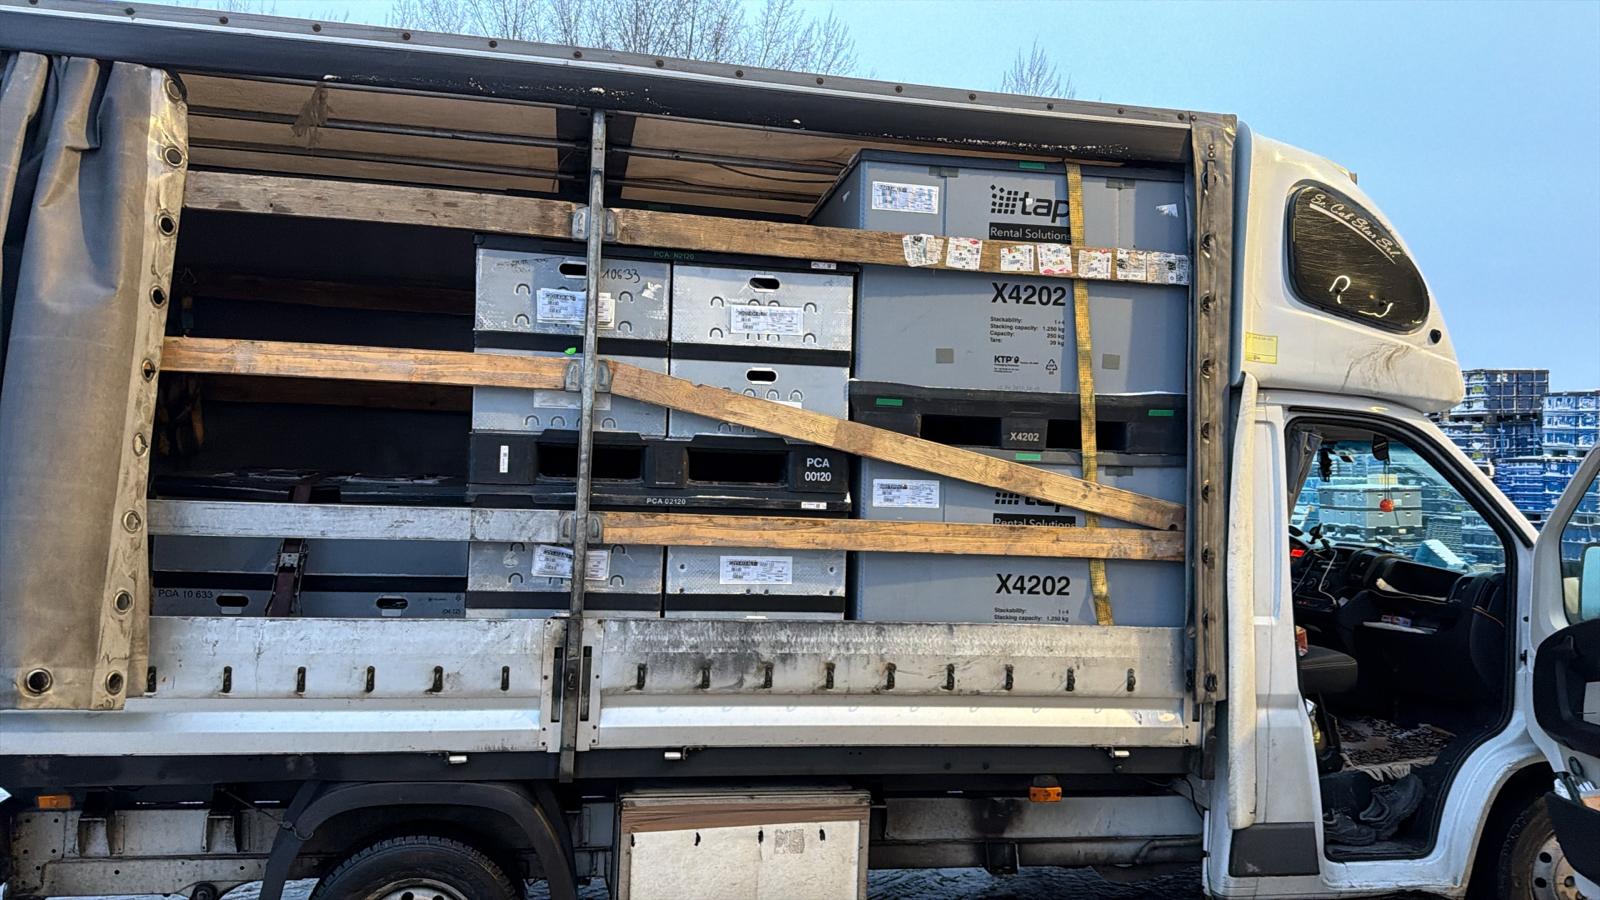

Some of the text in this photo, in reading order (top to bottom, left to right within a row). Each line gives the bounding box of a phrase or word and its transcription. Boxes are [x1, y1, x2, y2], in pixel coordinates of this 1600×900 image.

[1019, 191, 1070, 223] tap
[1330, 203, 1355, 219] Cab
[1351, 217, 1377, 239] Star
[990, 227, 1023, 238] Rental
[601, 268, 641, 284] 10633
[991, 282, 1067, 307] X4202
[994, 355, 1012, 363] KTP
[1010, 432, 1040, 442] X4202
[806, 457, 830, 468] PCA
[804, 471, 832, 482] 00120
[995, 573, 1071, 596] X4202
[158, 589, 213, 599] PCA 10 633
